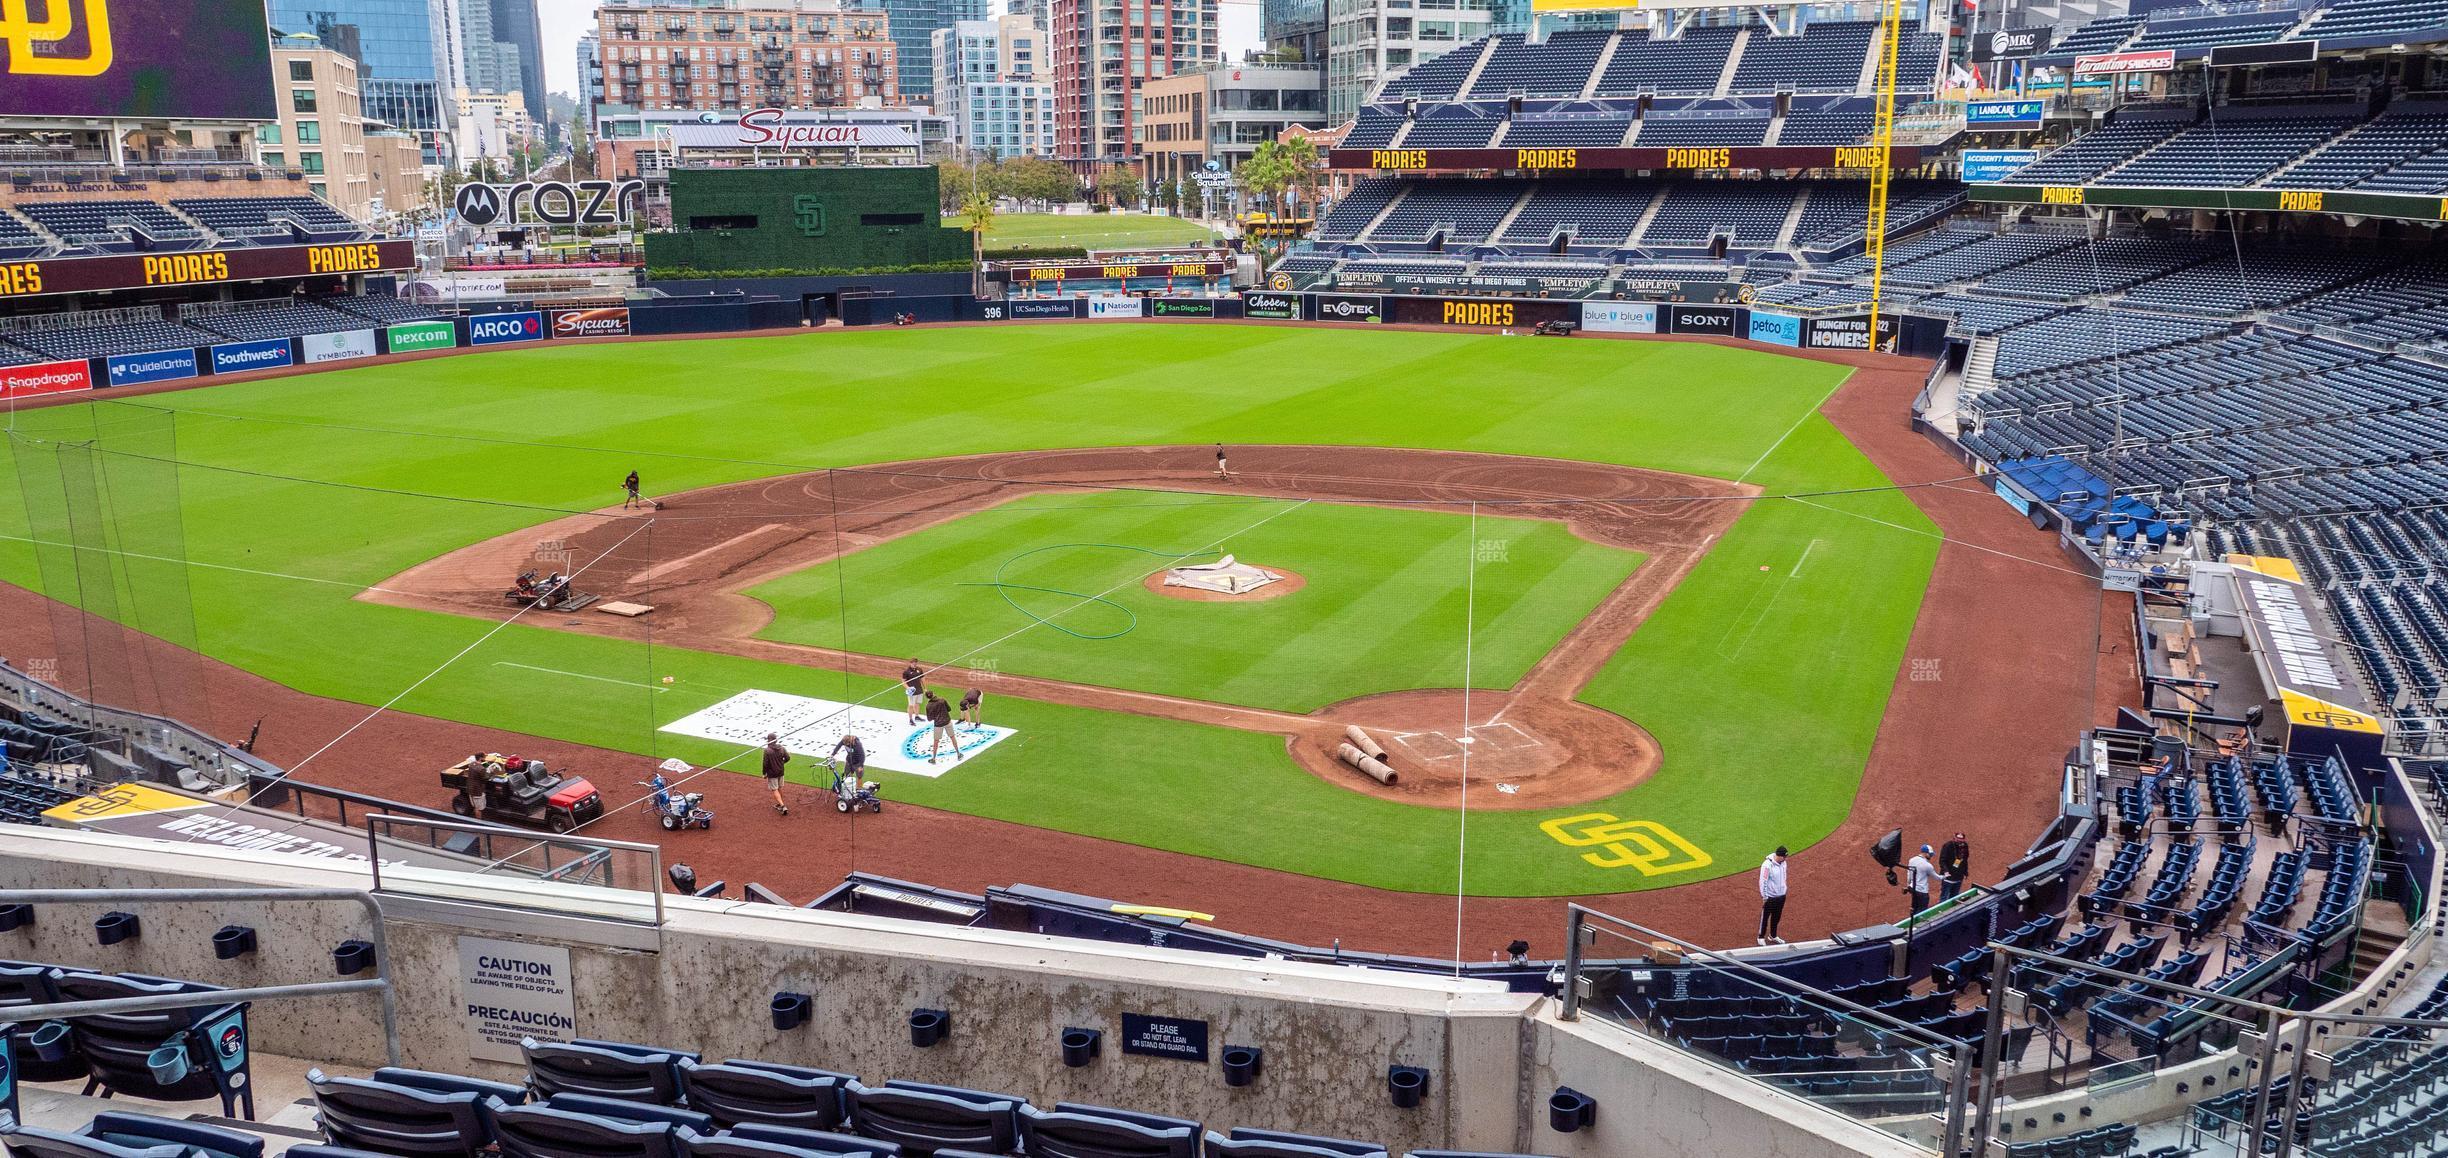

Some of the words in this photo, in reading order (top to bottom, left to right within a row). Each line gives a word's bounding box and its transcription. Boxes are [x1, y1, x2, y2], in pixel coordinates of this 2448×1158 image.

[2008, 34, 2035, 46] MRC
[2077, 57, 2127, 72] Tarantino
[1979, 105, 2015, 115] LANDCARE
[2018, 103, 2041, 114] LOGIC
[738, 108, 864, 154] Sycuan
[1372, 150, 1427, 169] PADRES
[1517, 149, 1576, 169] PADRES
[1666, 148, 1730, 168] PADRES
[1835, 147, 1882, 168] PADRES
[1191, 171, 1231, 180] Gallagher
[14, 185, 64, 194] ESTRELLA
[66, 184, 105, 192] JALISCO
[107, 183, 147, 192] LANDING
[1197, 179, 1226, 187] Square
[507, 179, 644, 225] razr
[2042, 187, 2083, 204] PADRES
[2279, 191, 2323, 211] PADRES
[308, 244, 380, 273] PADRES
[144, 252, 228, 284] PADRES
[1030, 268, 1066, 280] PADRES
[1103, 266, 1138, 279] PADRES
[1172, 264, 1206, 276] PADRES
[1336, 273, 1384, 283] TEMPLETON
[1395, 276, 1424, 284] OFFICIAL
[1425, 276, 1456, 285] WHISKEY
[1471, 277, 1484, 285] SAN
[1485, 278, 1502, 286] DIEGO
[1503, 278, 1527, 286] PADRES
[1538, 279, 1591, 289] TEMPLETON
[1625, 280, 1681, 291] TEMPLETON
[1249, 295, 1288, 307] Chosen
[984, 307, 1002, 319] 396
[1036, 306, 1051, 314] Diego
[1052, 305, 1069, 313] Health
[1180, 305, 1198, 313] Diego
[1323, 301, 1374, 316] EVOTEK
[1443, 301, 1514, 326] PADRES
[1584, 310, 1607, 320] blue
[1620, 311, 1643, 321] blue
[1681, 315, 1730, 326] SONY
[473, 320, 522, 338] ARCO
[558, 312, 622, 335] Sycuan
[1752, 319, 1781, 334] petco
[1816, 320, 1849, 330] HUNGRY
[1850, 321, 1867, 331] FOR
[1876, 320, 1889, 333] 322
[1811, 331, 1870, 348] HOMERS
[218, 348, 279, 365] Southwest
[317, 350, 365, 361] CYMBIOTIKA
[130, 358, 193, 375] QuidelOrtho
[8, 371, 83, 388] Snapdragon
[158, 813, 312, 851] WELCOME
[1539, 813, 1713, 877] SD
[896, 893, 936, 907] PADRES
[479, 956, 552, 976] CAUTION
[470, 978, 499, 987] LEAVING
[515, 983, 534, 991] FIELD
[488, 972, 512, 981] AWARE
[524, 976, 555, 986] OBJECTS
[468, 1004, 572, 1029] PRECAUCIÓN
[478, 1028, 507, 1037] OBJETOS
[512, 1025, 548, 1035] PENDIENTE
[1150, 1023, 1179, 1035] PLEASE
[496, 1038, 521, 1046] TERREN
[1173, 1036, 1187, 1044] LEAN
[1141, 1041, 1158, 1049] STAND
[1158, 1042, 1167, 1050] ON
[1167, 1044, 1185, 1052] GUARD
[1186, 1045, 1198, 1053] RAIL
